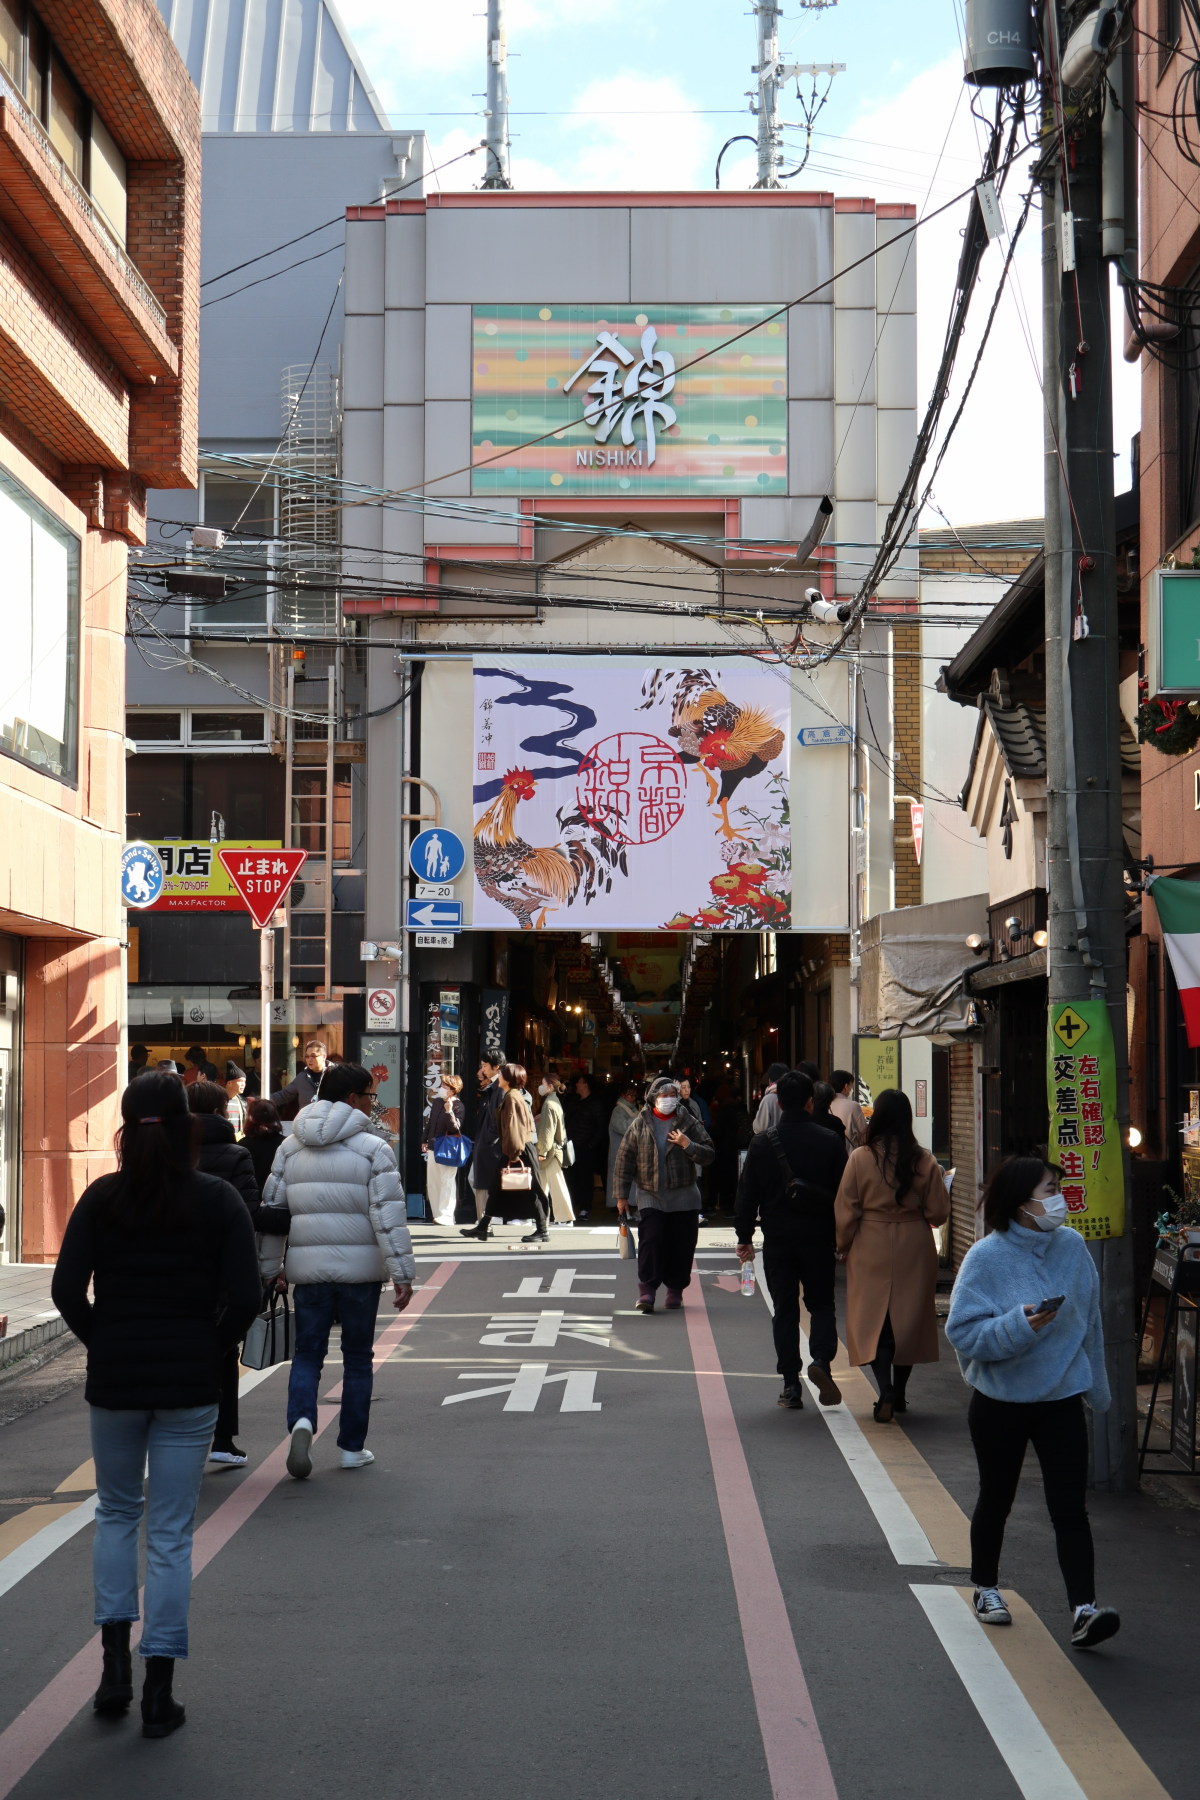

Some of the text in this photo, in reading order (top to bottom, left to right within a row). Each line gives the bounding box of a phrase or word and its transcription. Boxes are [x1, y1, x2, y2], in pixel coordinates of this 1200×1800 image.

[987, 31, 1021, 44] CH4
[563, 326, 677, 467] 錦
[576, 449, 642, 466] NISHIKI
[141, 849, 159, 872] Seiko
[238, 858, 289, 875] 止まれ
[246, 879, 281, 894] STOP
[417, 936, 452, 945] 自転車を除く
[428, 1002, 441, 1052] おかき処
[1053, 1054, 1087, 1214] 交差点注意
[441, 1268, 617, 1412] 止まれ
